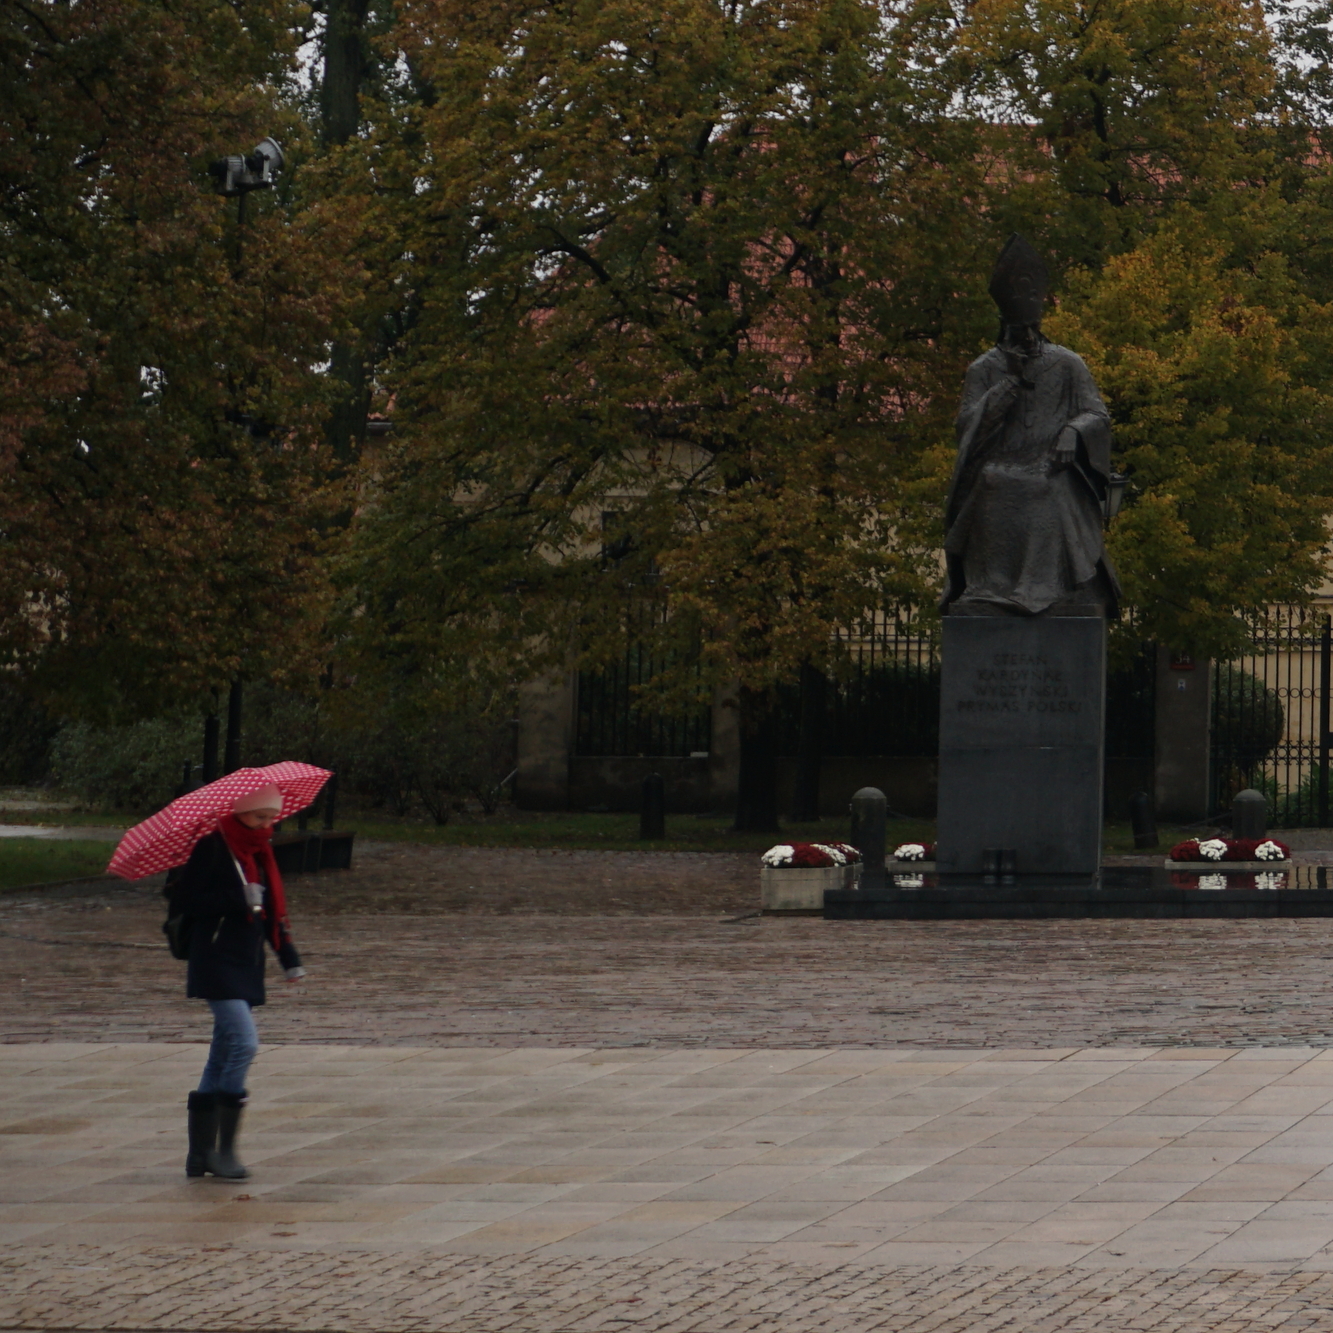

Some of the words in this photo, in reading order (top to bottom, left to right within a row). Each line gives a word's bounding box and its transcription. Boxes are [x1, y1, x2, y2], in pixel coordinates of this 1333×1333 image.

[993, 653, 1048, 665] STEFAN
[957, 700, 1020, 712] PRYMAS
[1027, 700, 1083, 713] POLSKI
